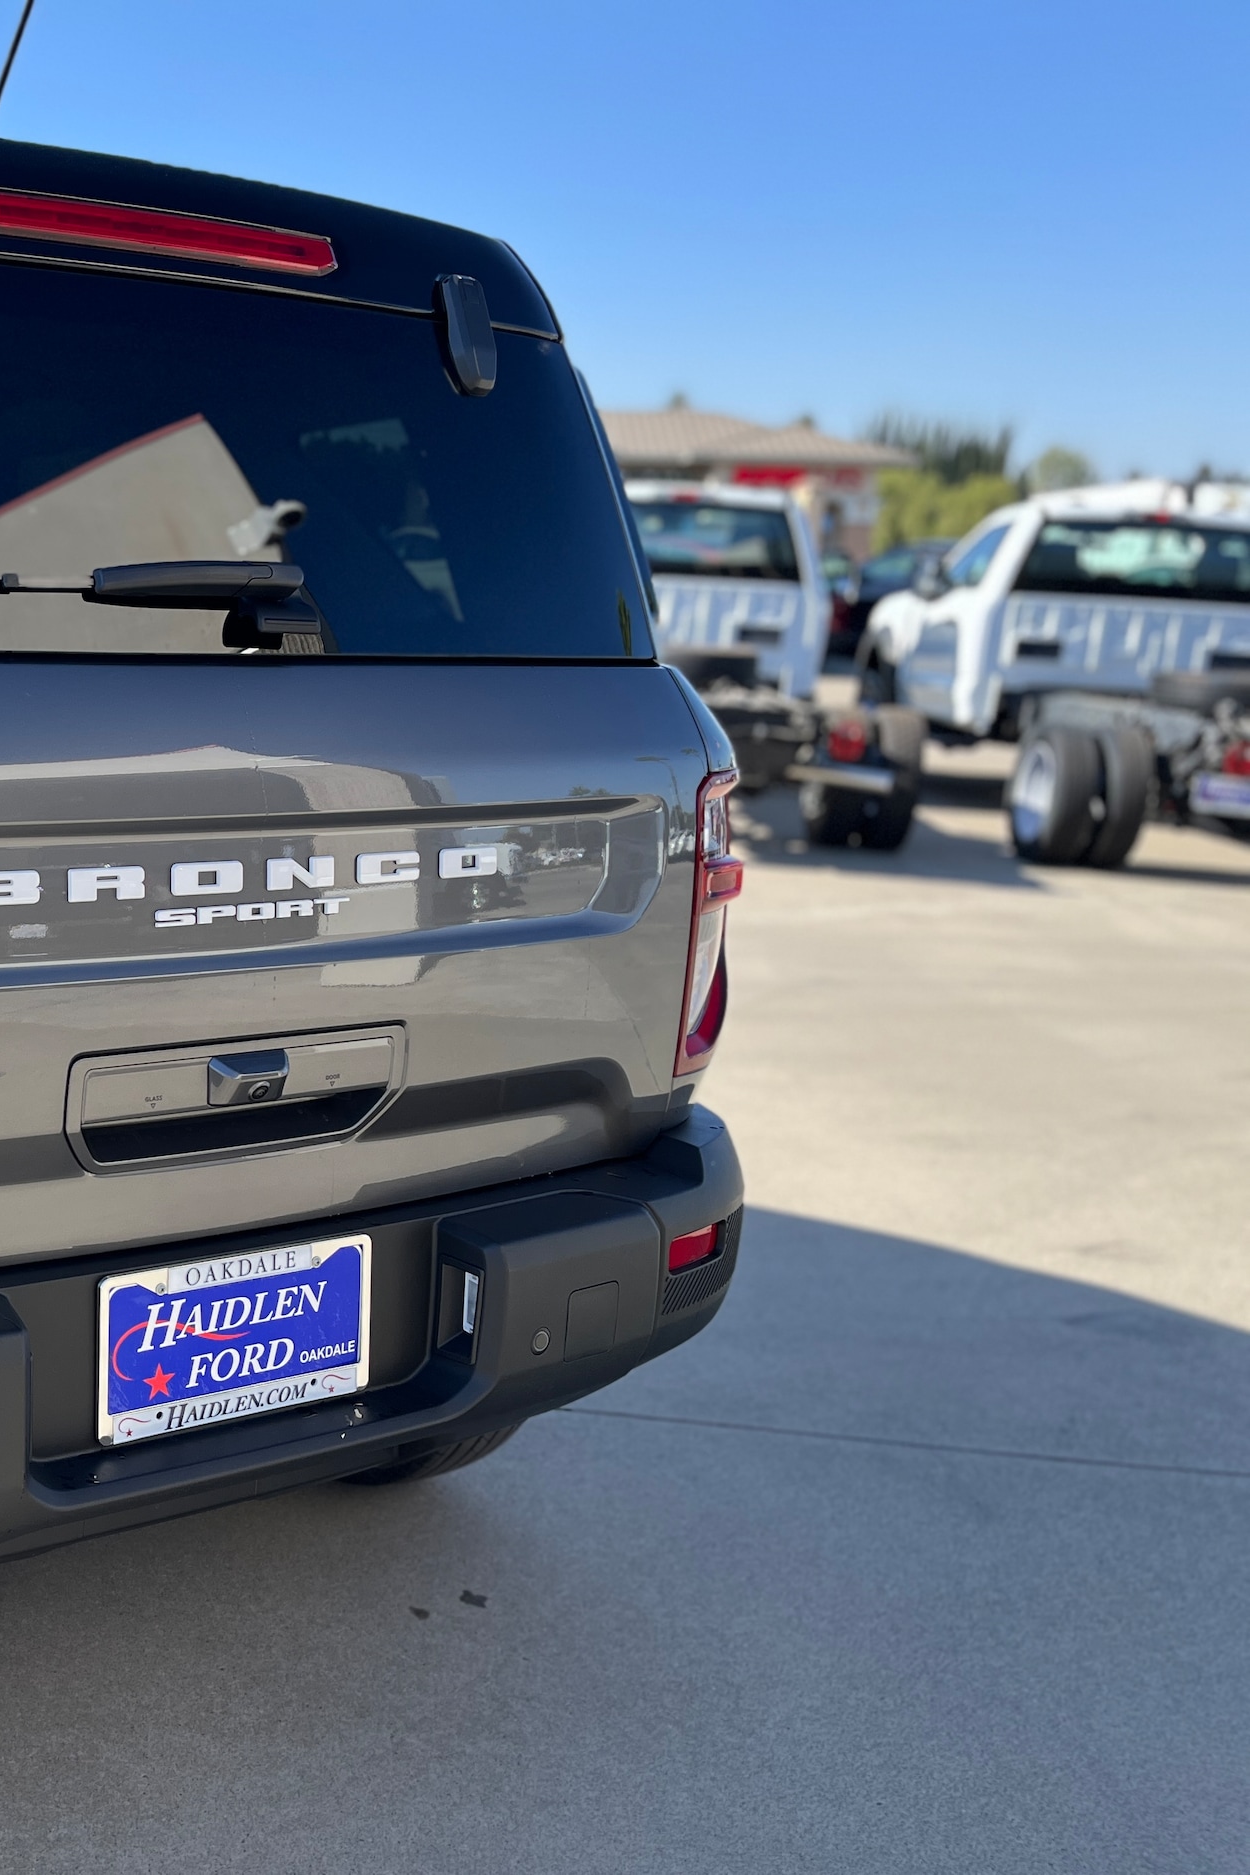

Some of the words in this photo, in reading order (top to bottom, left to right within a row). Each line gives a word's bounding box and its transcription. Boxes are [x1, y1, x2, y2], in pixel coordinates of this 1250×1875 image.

[153, 897, 350, 929] SPORT
[186, 1250, 297, 1286] OAKDALE
[137, 1281, 328, 1353] HAIDLEN
[185, 1337, 295, 1389] FORD
[300, 1340, 356, 1365] OAKDALE
[165, 1382, 309, 1431] HAIDLEN.COM
